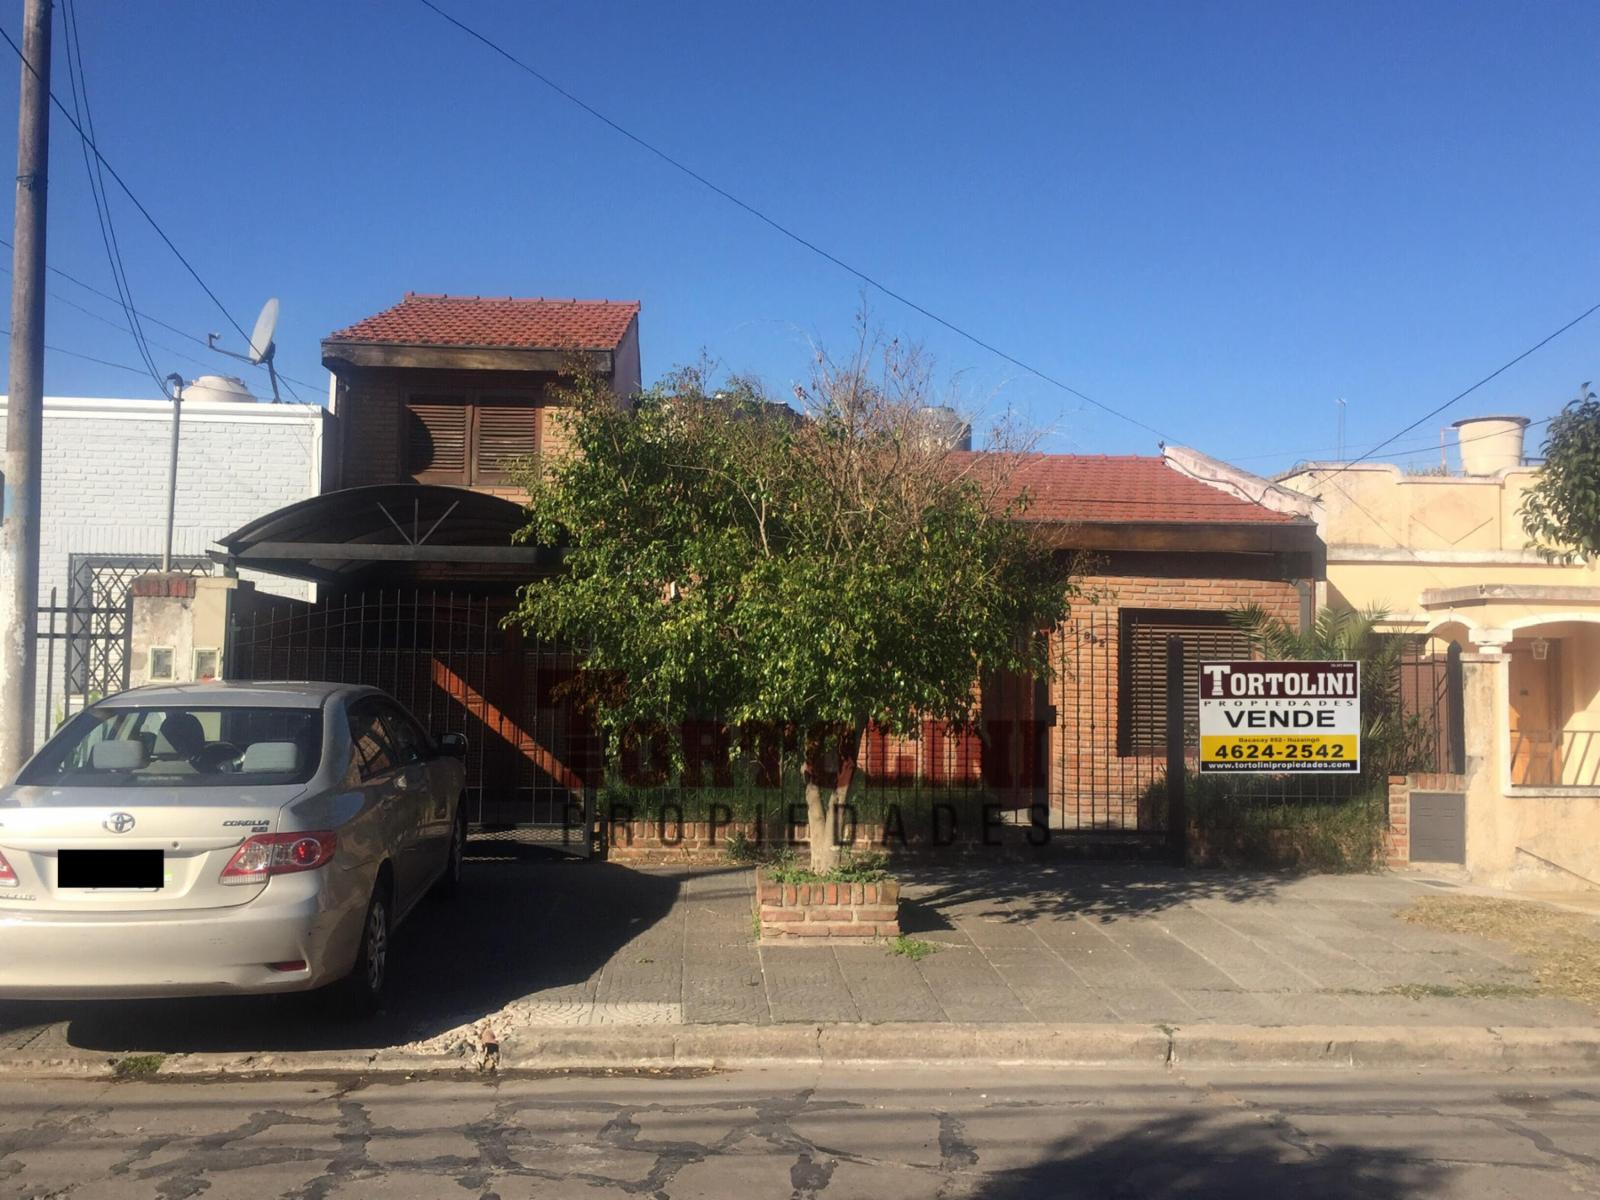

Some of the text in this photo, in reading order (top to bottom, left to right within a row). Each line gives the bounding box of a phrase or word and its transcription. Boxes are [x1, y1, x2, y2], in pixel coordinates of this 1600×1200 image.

[1203, 665, 1354, 696] TORTOLINI
[1223, 710, 1336, 728] VENDE
[1215, 744, 1344, 759] 4624-2542
[1208, 760, 1351, 770] www.tortolinipropiedades.com
